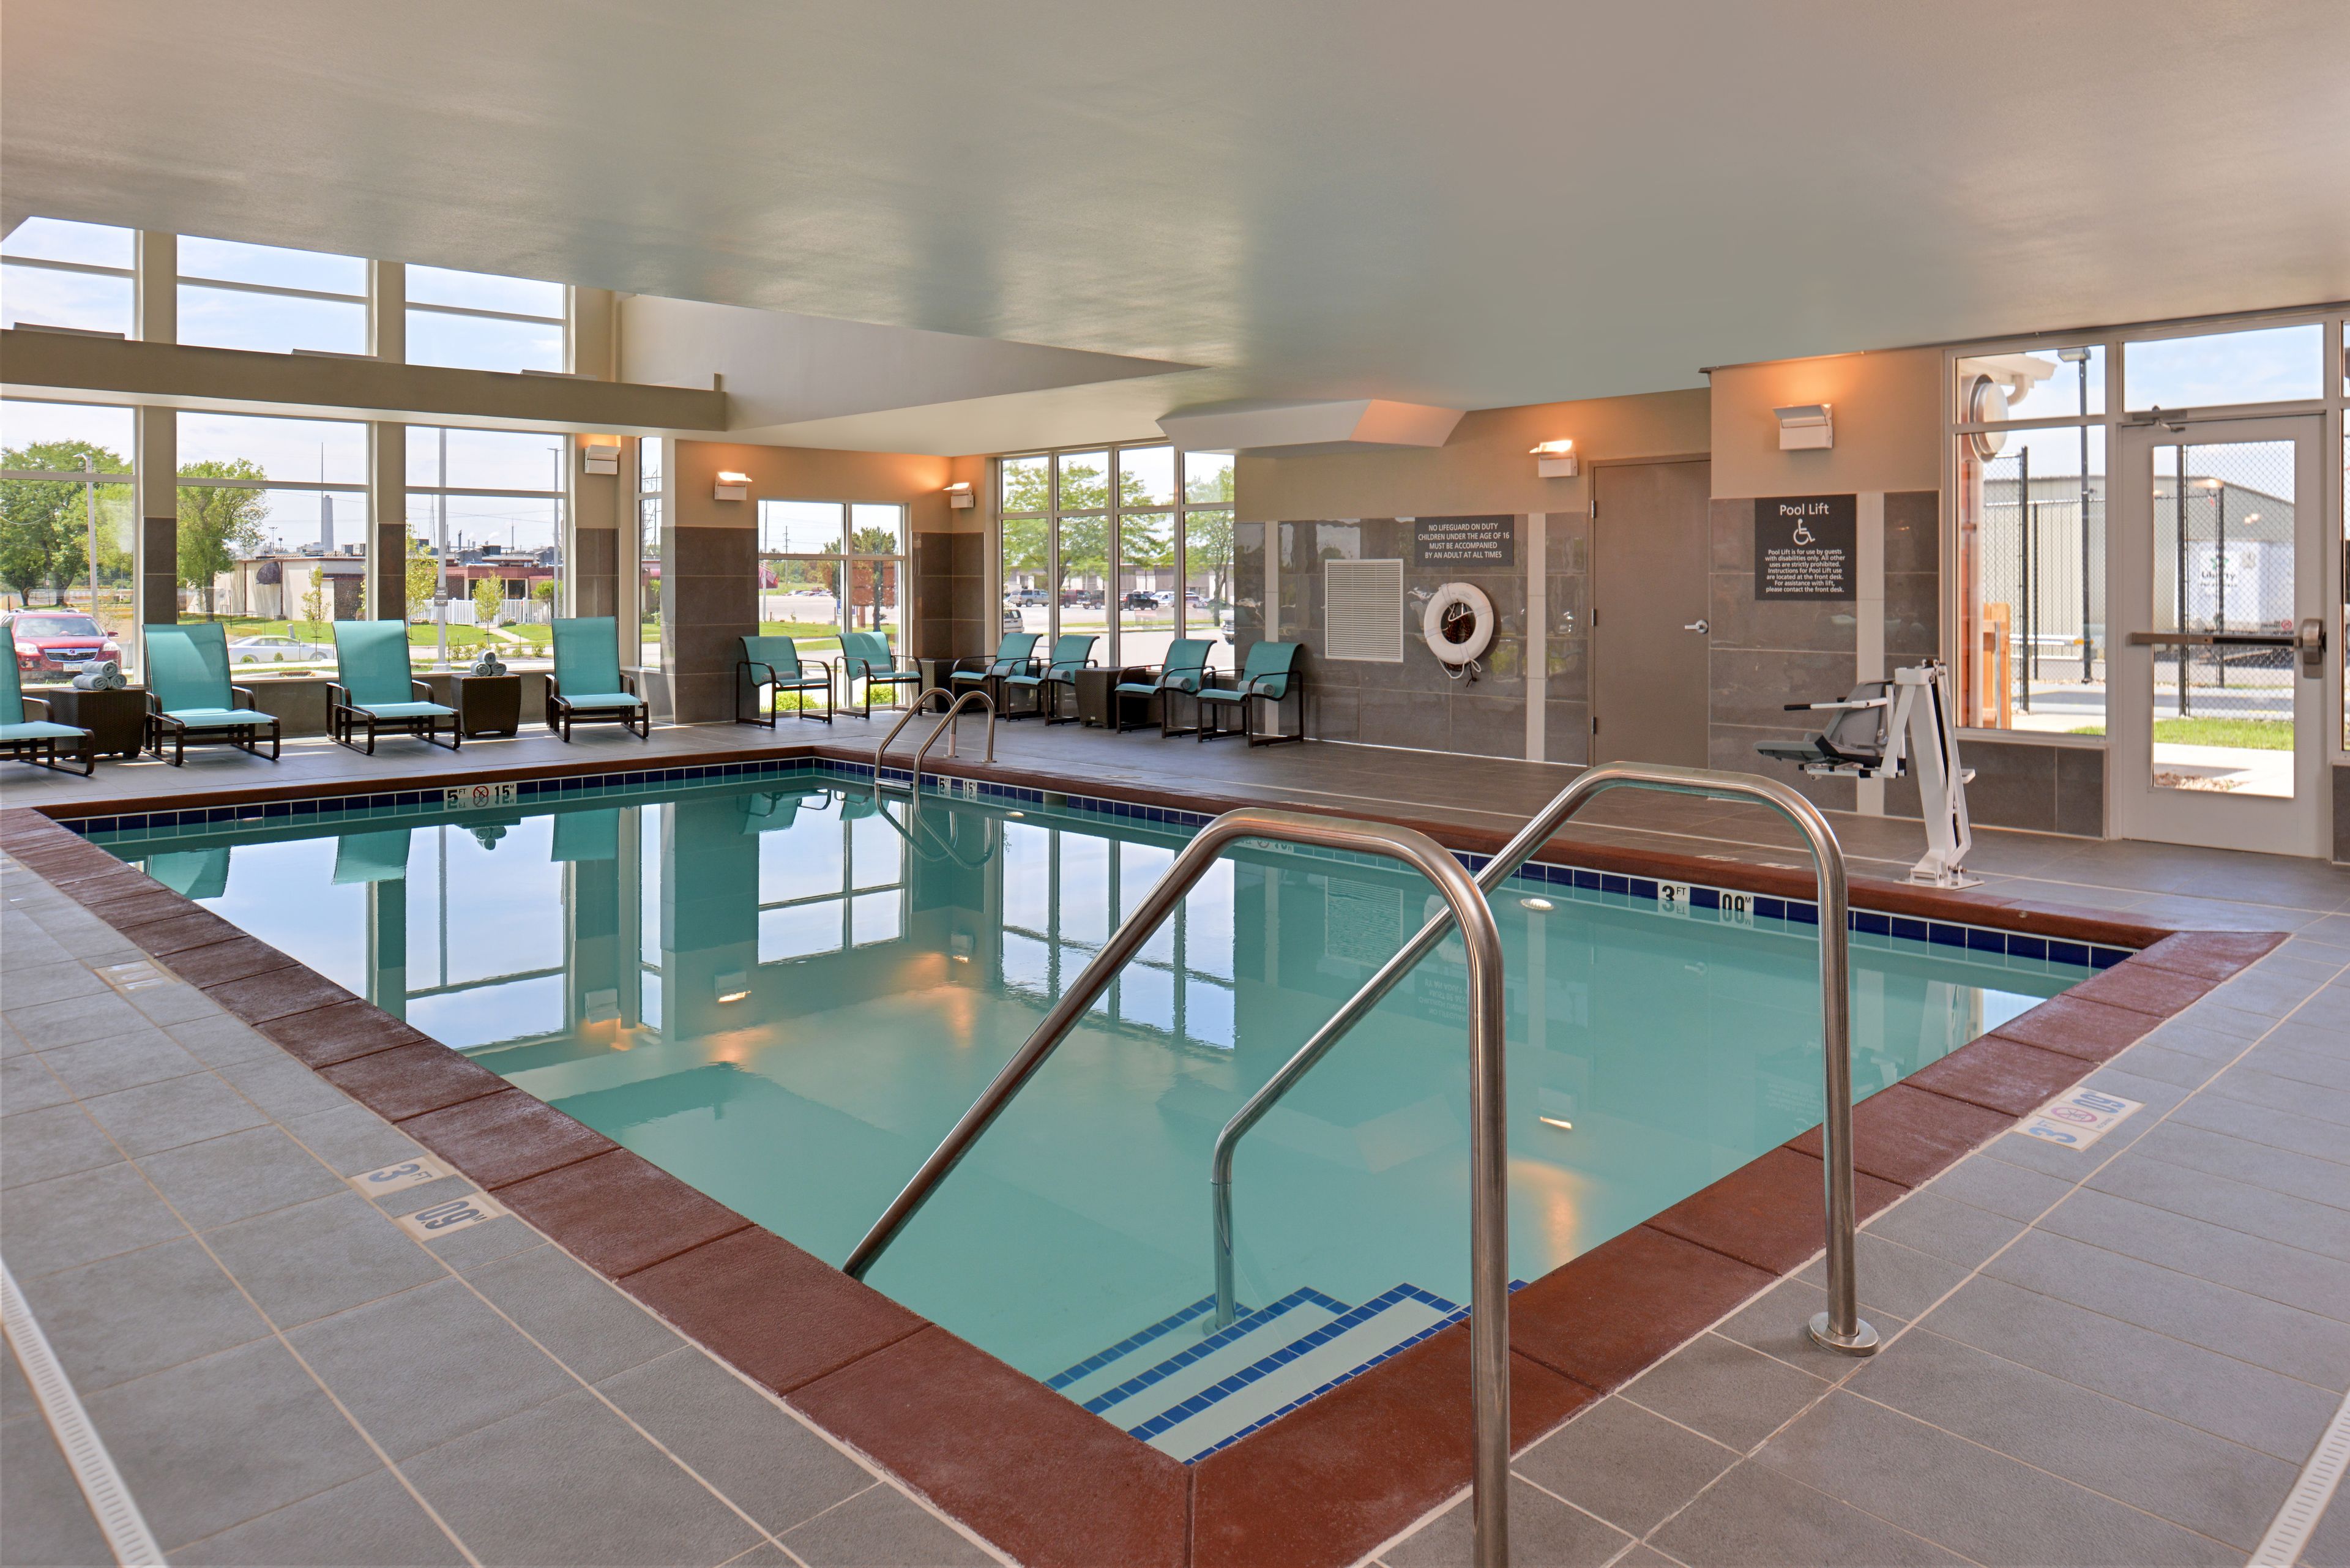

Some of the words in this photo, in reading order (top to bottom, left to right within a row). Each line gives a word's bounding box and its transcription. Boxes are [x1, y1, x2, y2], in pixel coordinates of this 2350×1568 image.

[1780, 504, 1805, 515] Pool
[1809, 502, 1829, 515] Lift
[1662, 885, 1675, 901] 3
[1676, 887, 1686, 895] FT
[2028, 1127, 2077, 1143] 3
[368, 1163, 420, 1182] 3
[410, 1170, 433, 1181] FT
